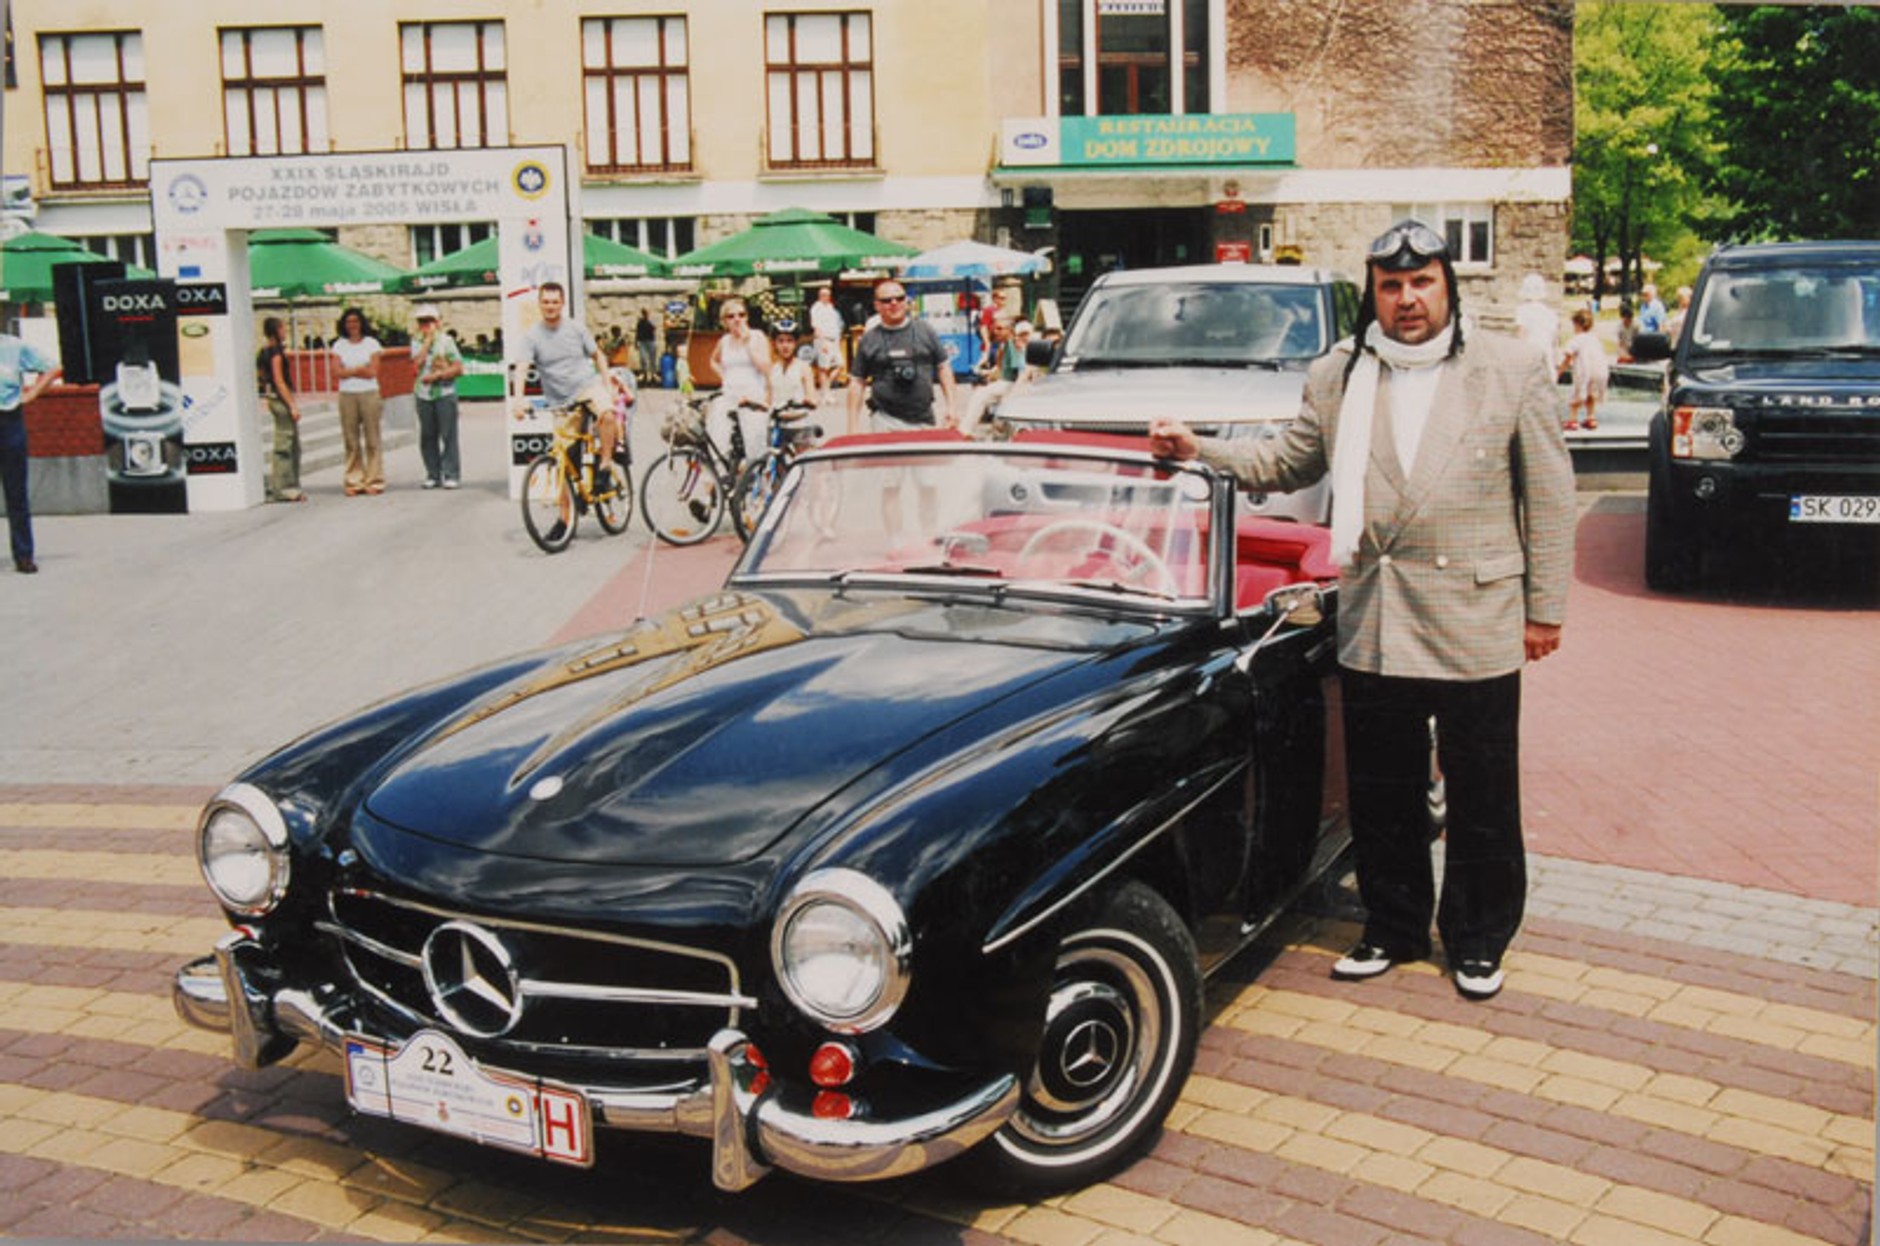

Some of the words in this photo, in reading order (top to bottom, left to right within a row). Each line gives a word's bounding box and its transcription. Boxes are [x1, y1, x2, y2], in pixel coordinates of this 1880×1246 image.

[1099, 117, 1255, 134] RESTAURACJA
[1085, 140, 1137, 158] DOM
[1145, 137, 1271, 158] ZDROJOWY
[345, 180, 499, 199] ZABYTKOWYCH
[102, 294, 167, 312] DOXA
[176, 287, 223, 303] OXA
[1762, 396, 1832, 406] LAND
[1849, 396, 1880, 407] RO
[1804, 498, 1831, 517] SK
[1840, 498, 1880, 518] 029
[420, 1045, 455, 1076] 22
[543, 1098, 577, 1152] H
